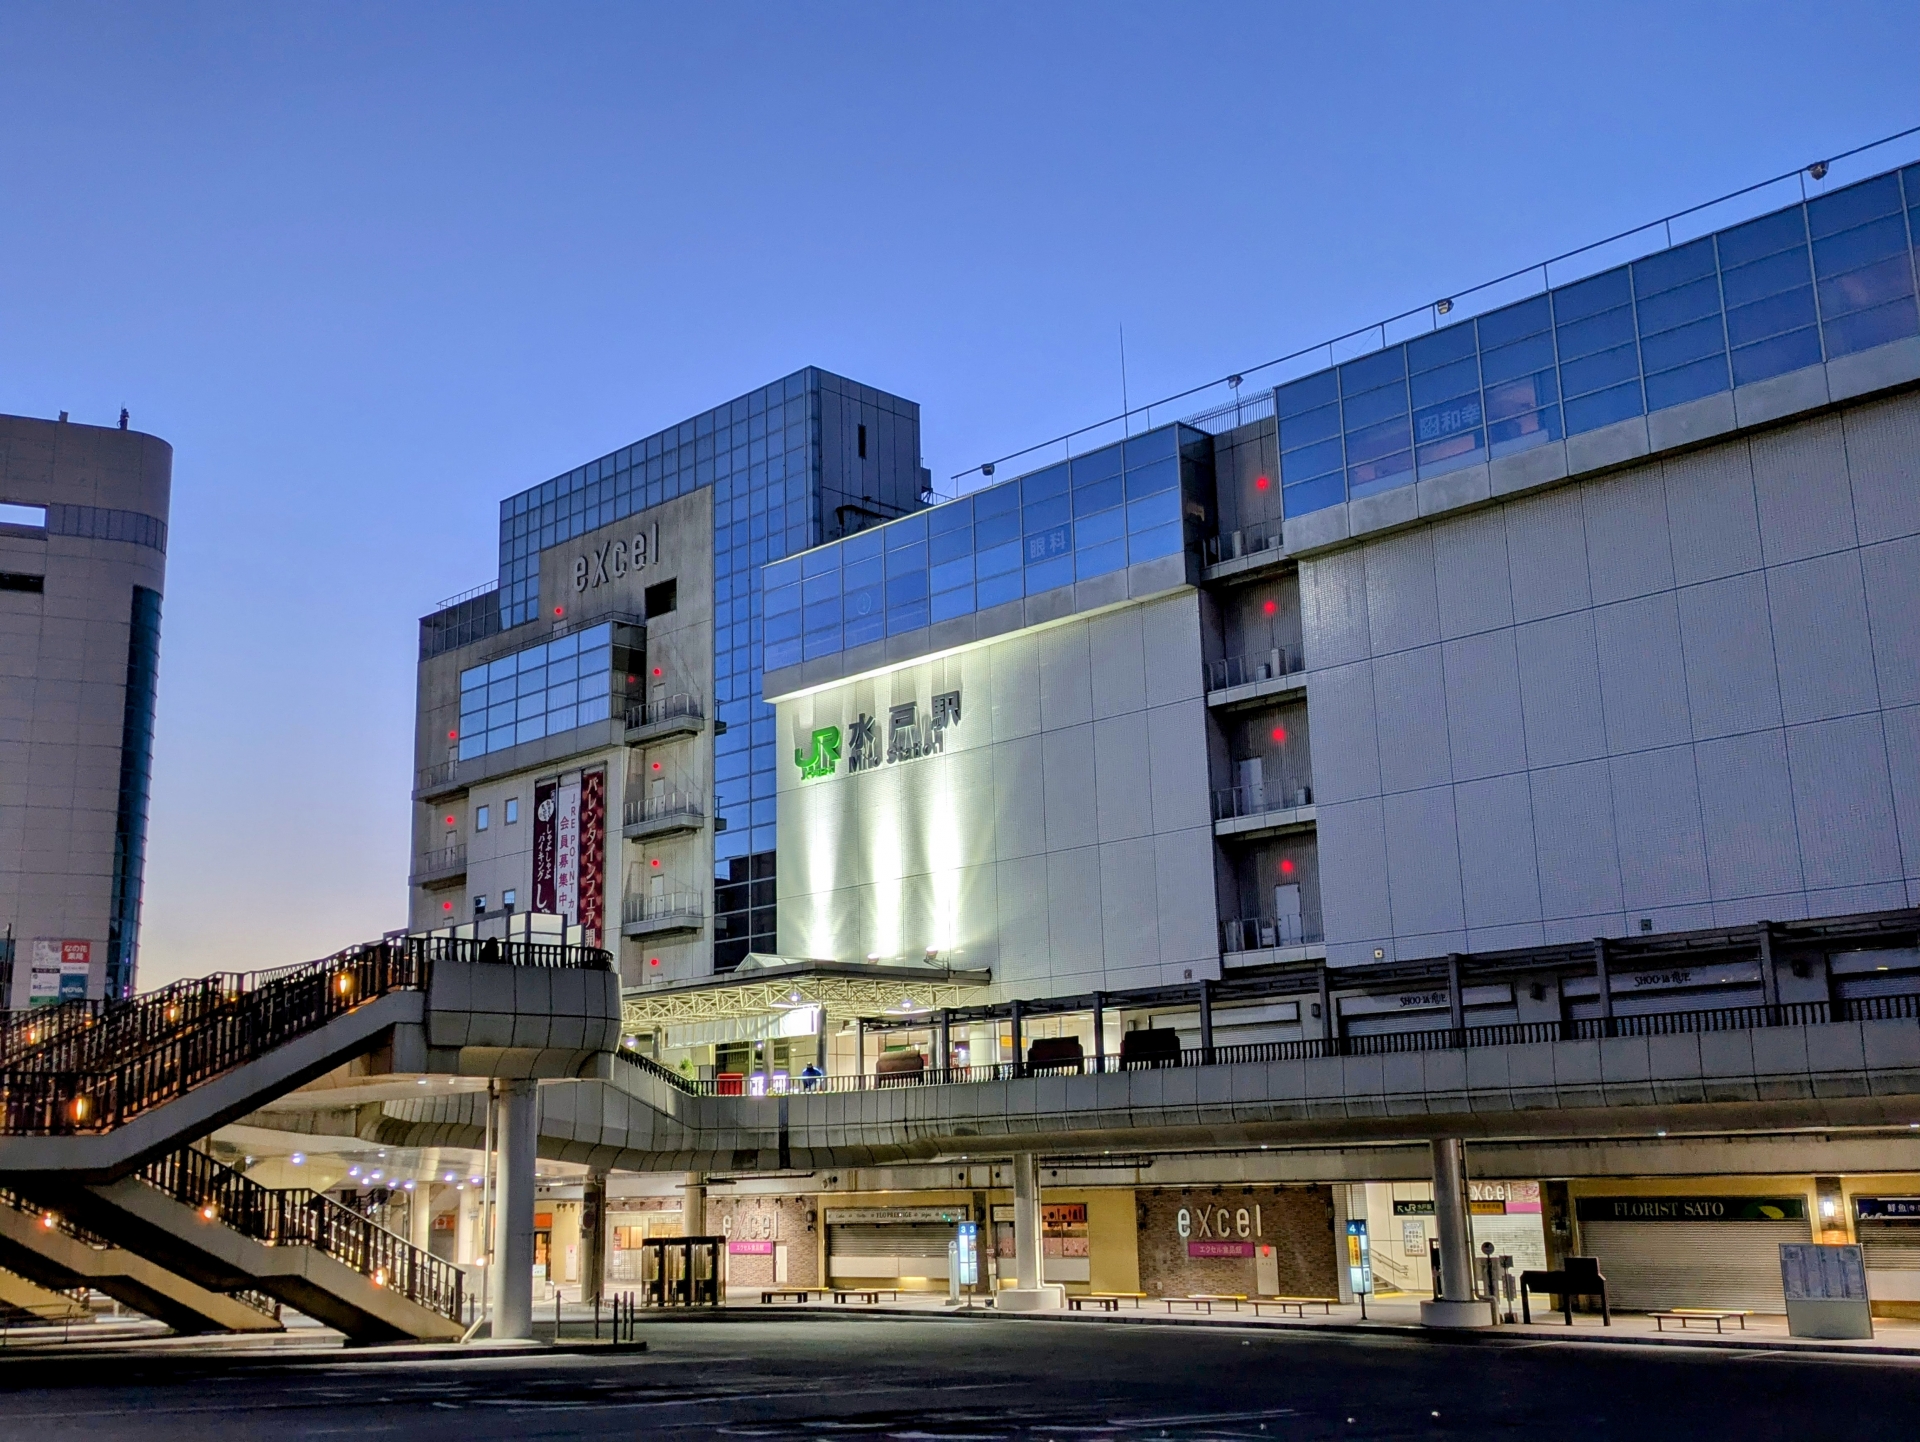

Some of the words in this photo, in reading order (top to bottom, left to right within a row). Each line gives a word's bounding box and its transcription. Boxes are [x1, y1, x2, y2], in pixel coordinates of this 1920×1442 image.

[1030, 530, 1066, 559] 眼科
[848, 690, 961, 749] 水戸駅
[795, 725, 842, 769] JR
[64, 945, 88, 953] なの花
[1470, 1183, 1512, 1201] xcel
[1404, 1203, 1416, 1212] JR
[1614, 1202, 1678, 1216] FLORIST
[1684, 1202, 1724, 1216] SATO
[1177, 1204, 1262, 1237] excel
[961, 1225, 966, 1233] 3
[969, 1225, 975, 1233] 3
[1349, 1224, 1356, 1233] 4
[1361, 1224, 1365, 1232] 4
[1199, 1245, 1243, 1254] エクセル食品館
